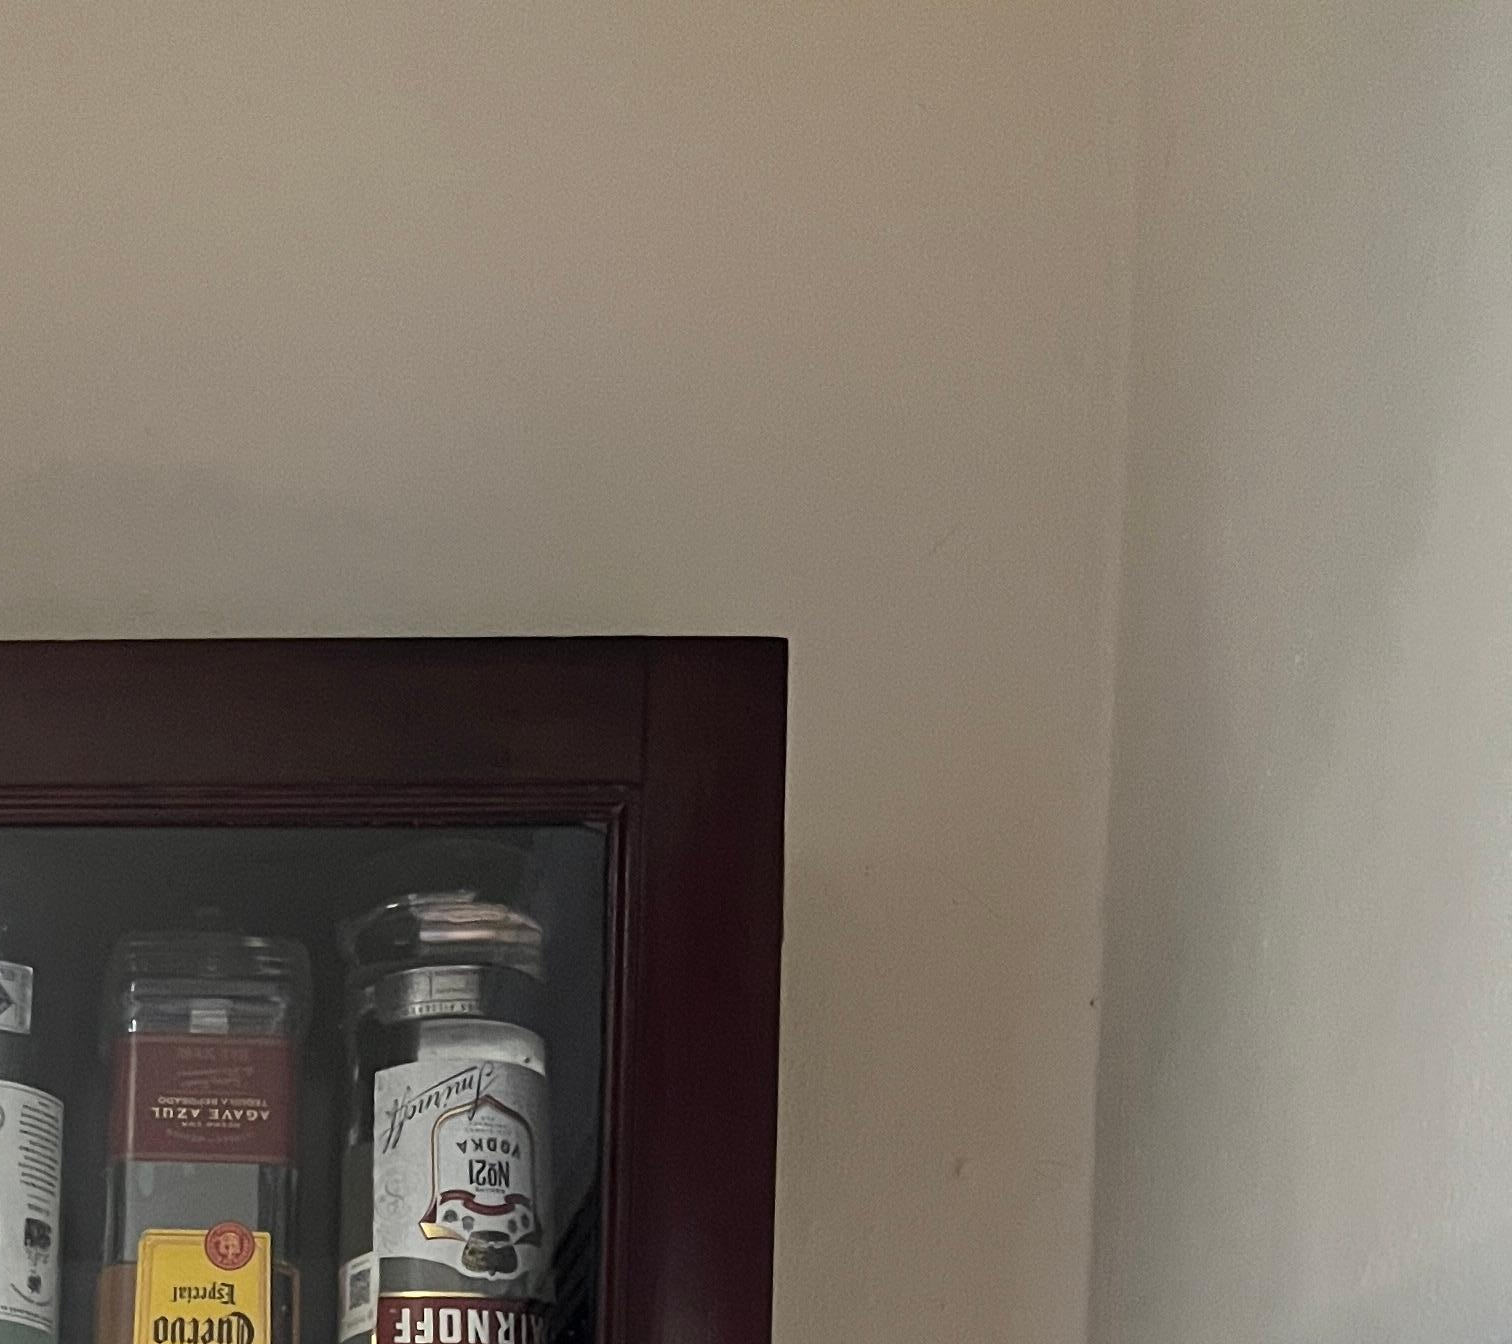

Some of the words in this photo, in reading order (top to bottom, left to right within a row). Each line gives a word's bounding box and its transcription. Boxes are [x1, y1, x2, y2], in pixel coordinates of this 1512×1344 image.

[150, 1106, 201, 1120] AZUL
[208, 1107, 271, 1121] AGAVE
[382, 1062, 498, 1154] Smirnoff
[455, 1137, 521, 1160] VODKA
[171, 1282, 236, 1306] Especial
